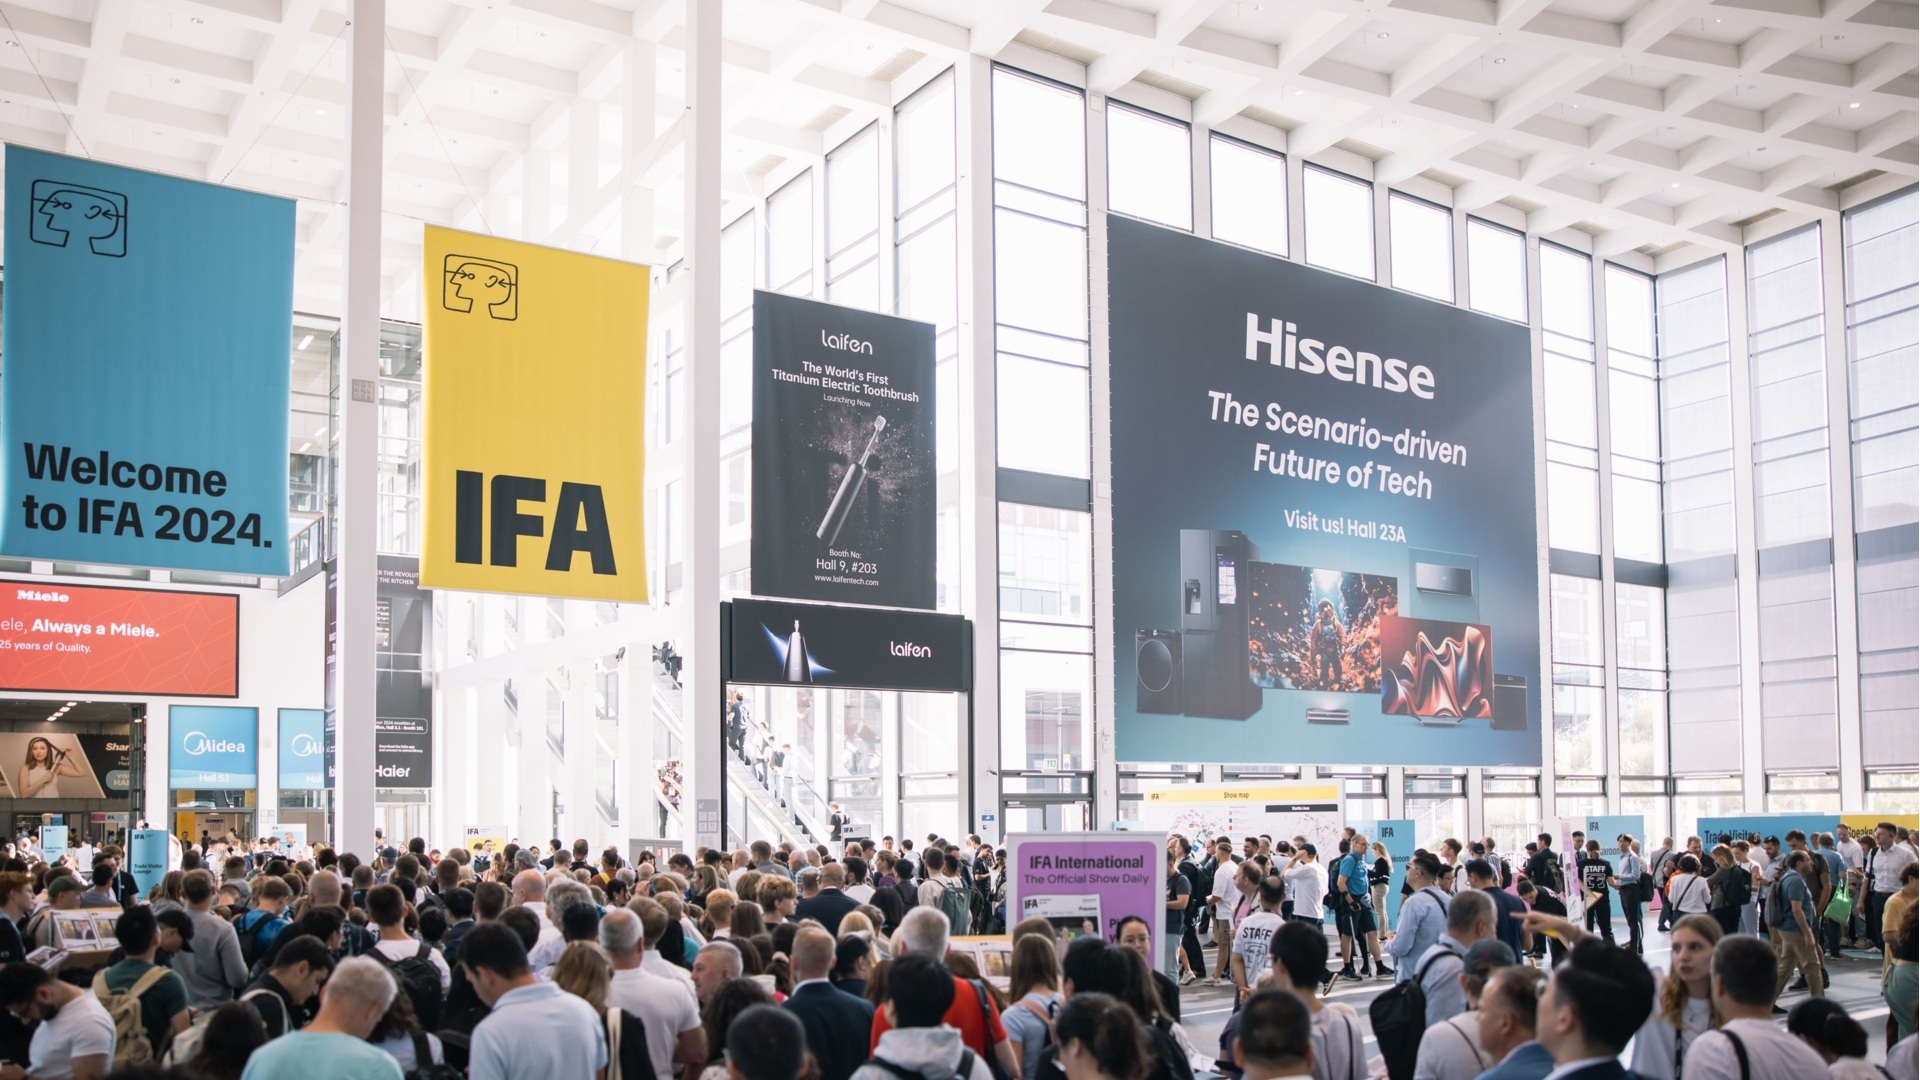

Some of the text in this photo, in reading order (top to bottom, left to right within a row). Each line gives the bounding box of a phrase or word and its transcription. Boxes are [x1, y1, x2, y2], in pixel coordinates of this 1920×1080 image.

[822, 330, 872, 355] laifen
[1246, 312, 1435, 400] Hisense
[802, 361, 888, 385] The World's First
[772, 369, 918, 402] Titanium Electric Toothbrush
[824, 394, 871, 408] Launching Now
[1208, 390, 1467, 466] The Scenario-driven
[24, 442, 227, 497] Welcome
[1254, 443, 1432, 500] Future of Tech
[23, 495, 272, 548] to IFA 2024.
[456, 470, 617, 575] IFA
[1284, 510, 1406, 543] Visit us! Hall 23A
[830, 549, 850, 558] Booth
[816, 558, 877, 574] Hall 9, #203
[814, 575, 878, 586] www.laifentech.com
[17, 590, 70, 602] Miele
[0, 617, 160, 638] ele, Always a Miele.
[0, 640, 92, 654] 25 years of Quality.
[890, 641, 931, 658] laifen
[106, 742, 130, 751] Shar
[191, 736, 246, 753] Midea
[1382, 827, 1394, 838] IFA
[1590, 822, 1599, 831] IFA
[1704, 830, 1726, 844] Trad
[1030, 855, 1143, 869] IFA International
[1024, 873, 1149, 885] The Official Show Daily
[1024, 899, 1038, 909] IFA
[1243, 927, 1272, 940] STAFF
